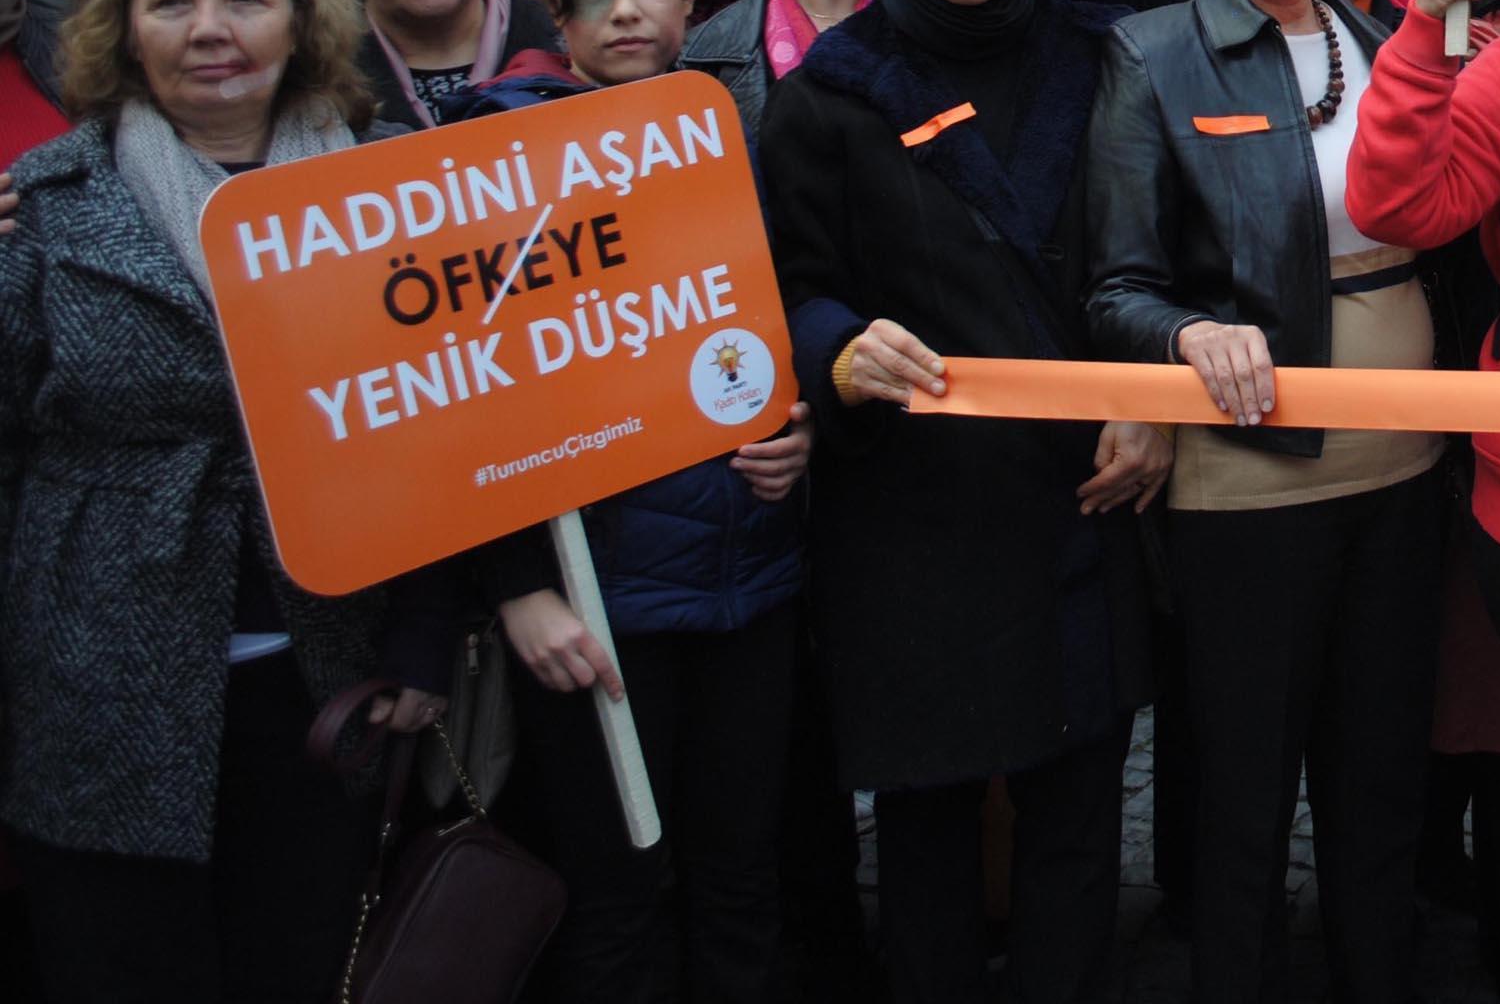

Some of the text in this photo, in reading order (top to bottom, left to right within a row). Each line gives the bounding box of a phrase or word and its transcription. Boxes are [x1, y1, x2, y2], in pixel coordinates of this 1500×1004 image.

[237, 108, 724, 280] HADDİNİ AŞAN
[383, 213, 626, 326] ÖFKEYE
[308, 263, 737, 440] YENİK DÜŞME
[476, 418, 642, 485] #TuruncuÇizgimiz
